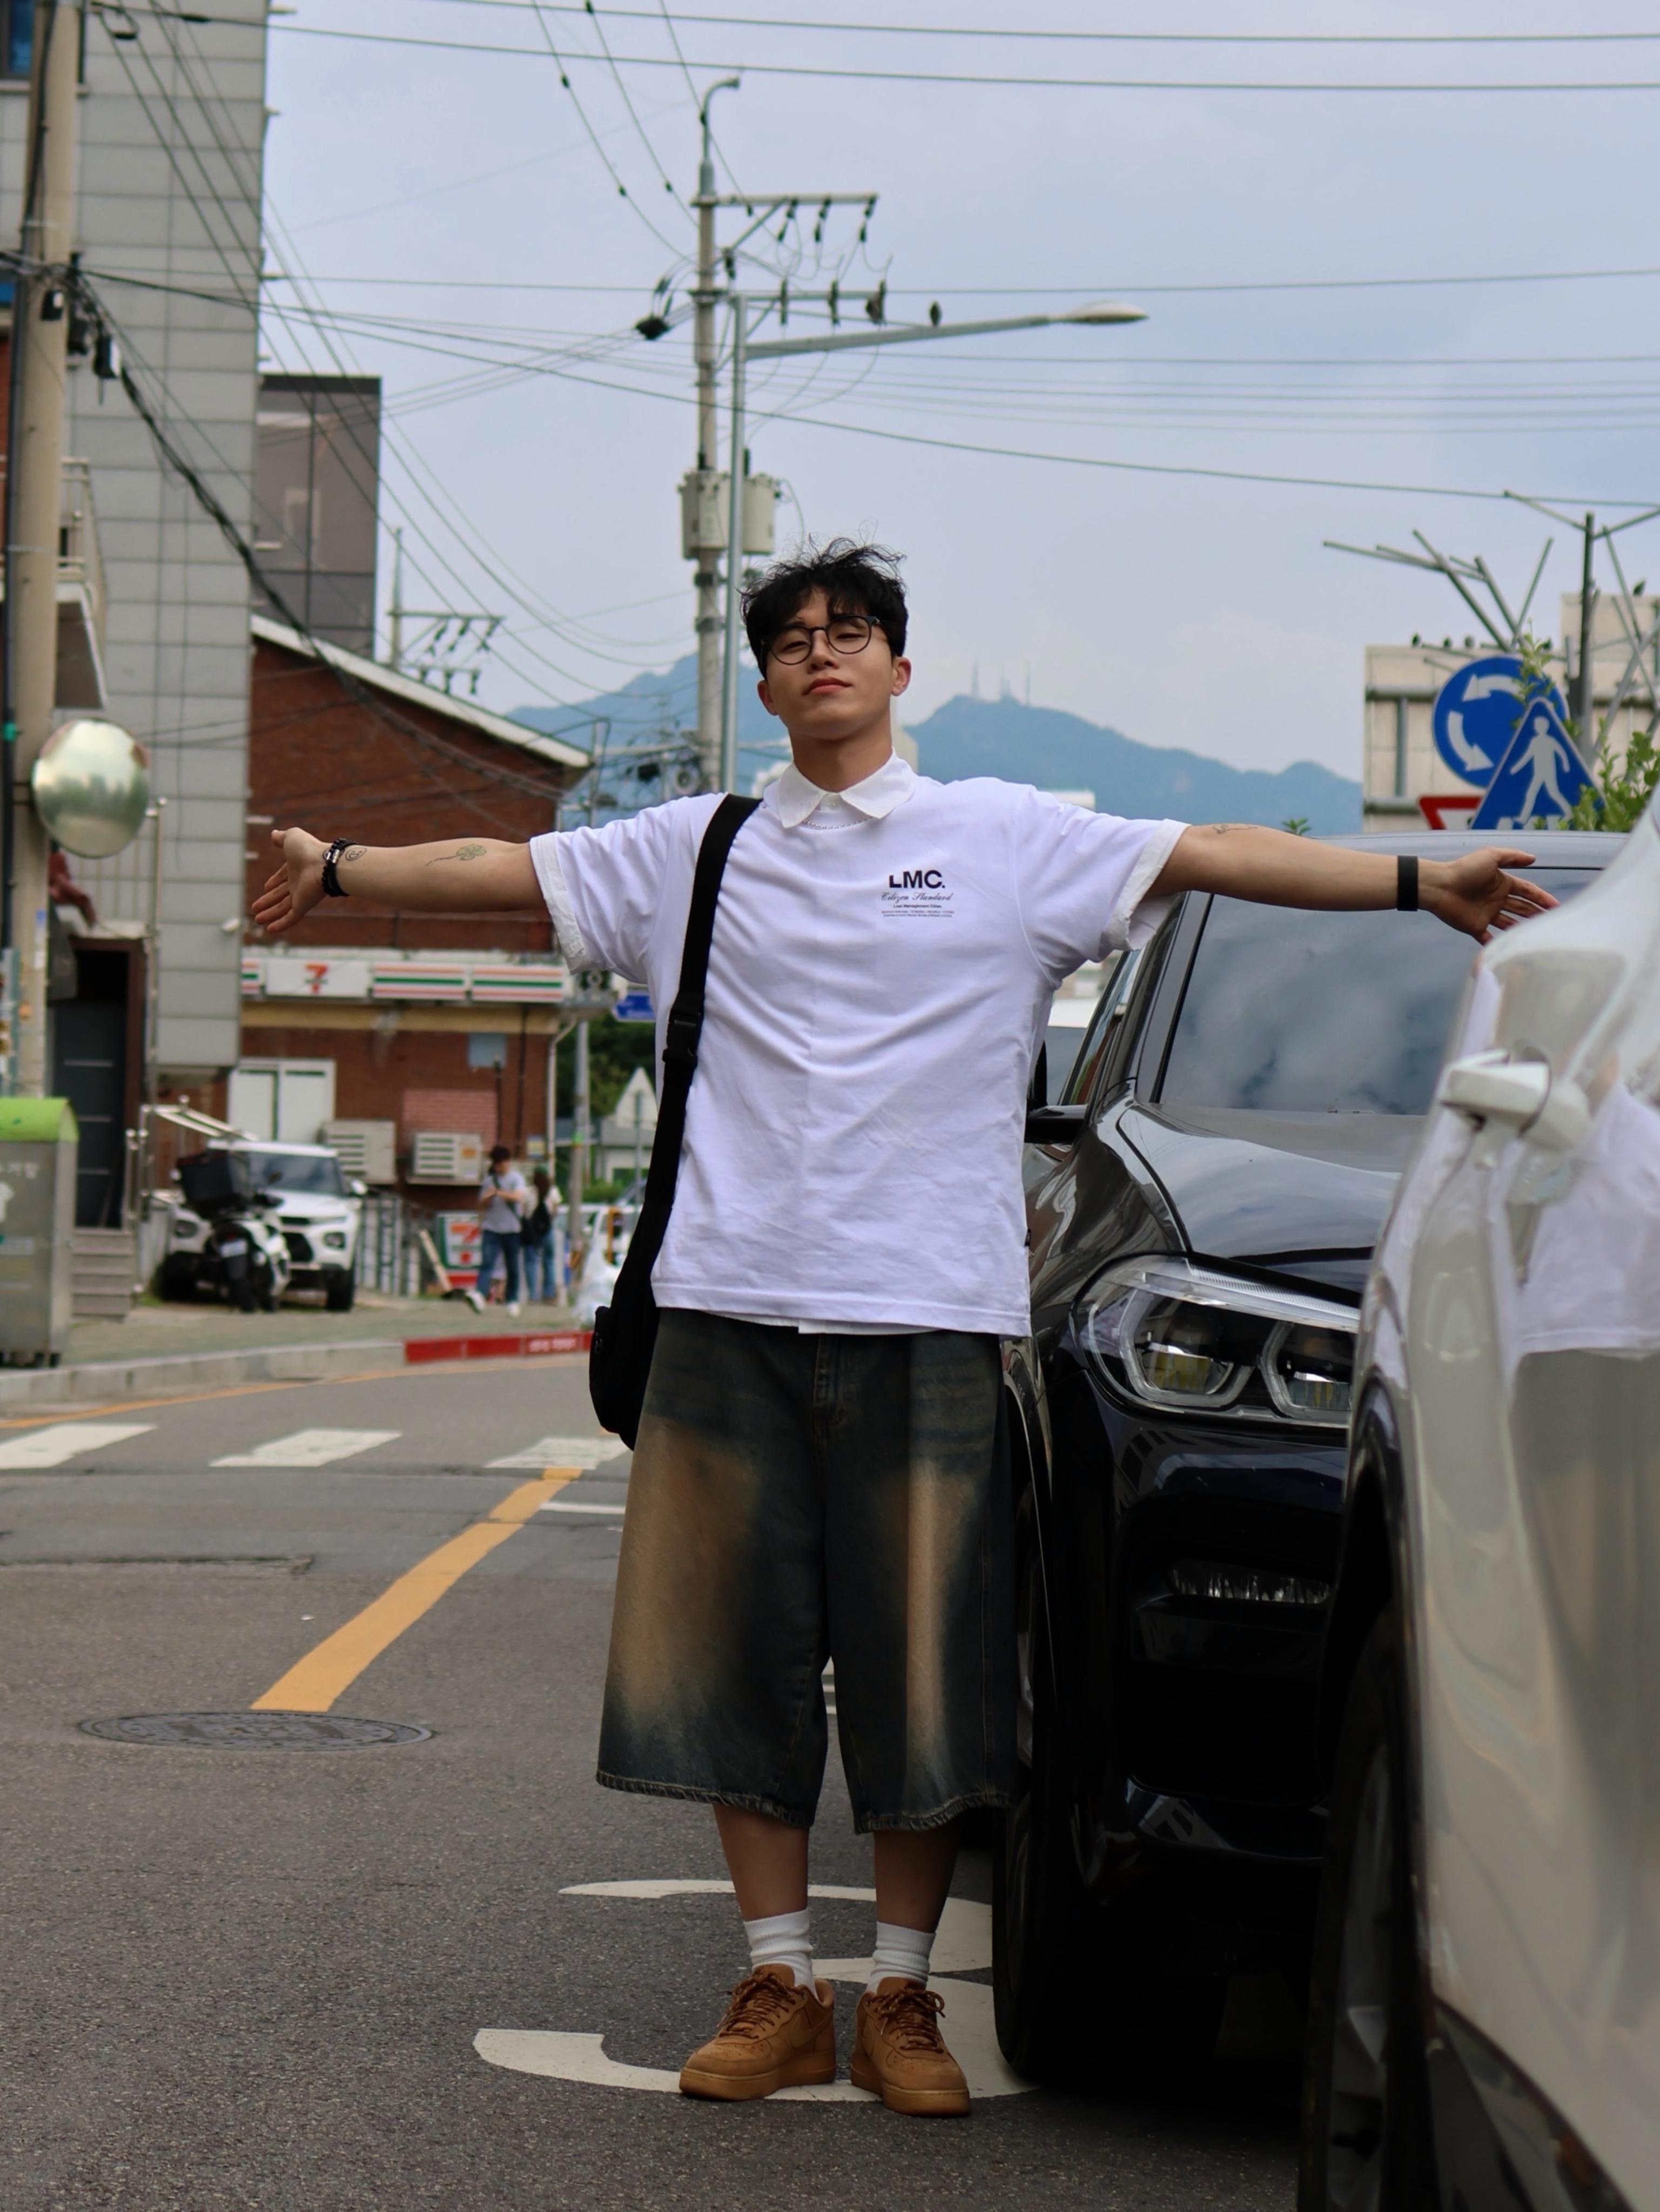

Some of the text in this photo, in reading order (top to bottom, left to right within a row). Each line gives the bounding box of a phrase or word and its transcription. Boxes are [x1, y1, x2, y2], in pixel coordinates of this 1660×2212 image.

[889, 869, 945, 889] LMC.
[881, 892, 954, 903] Citizen Standard
